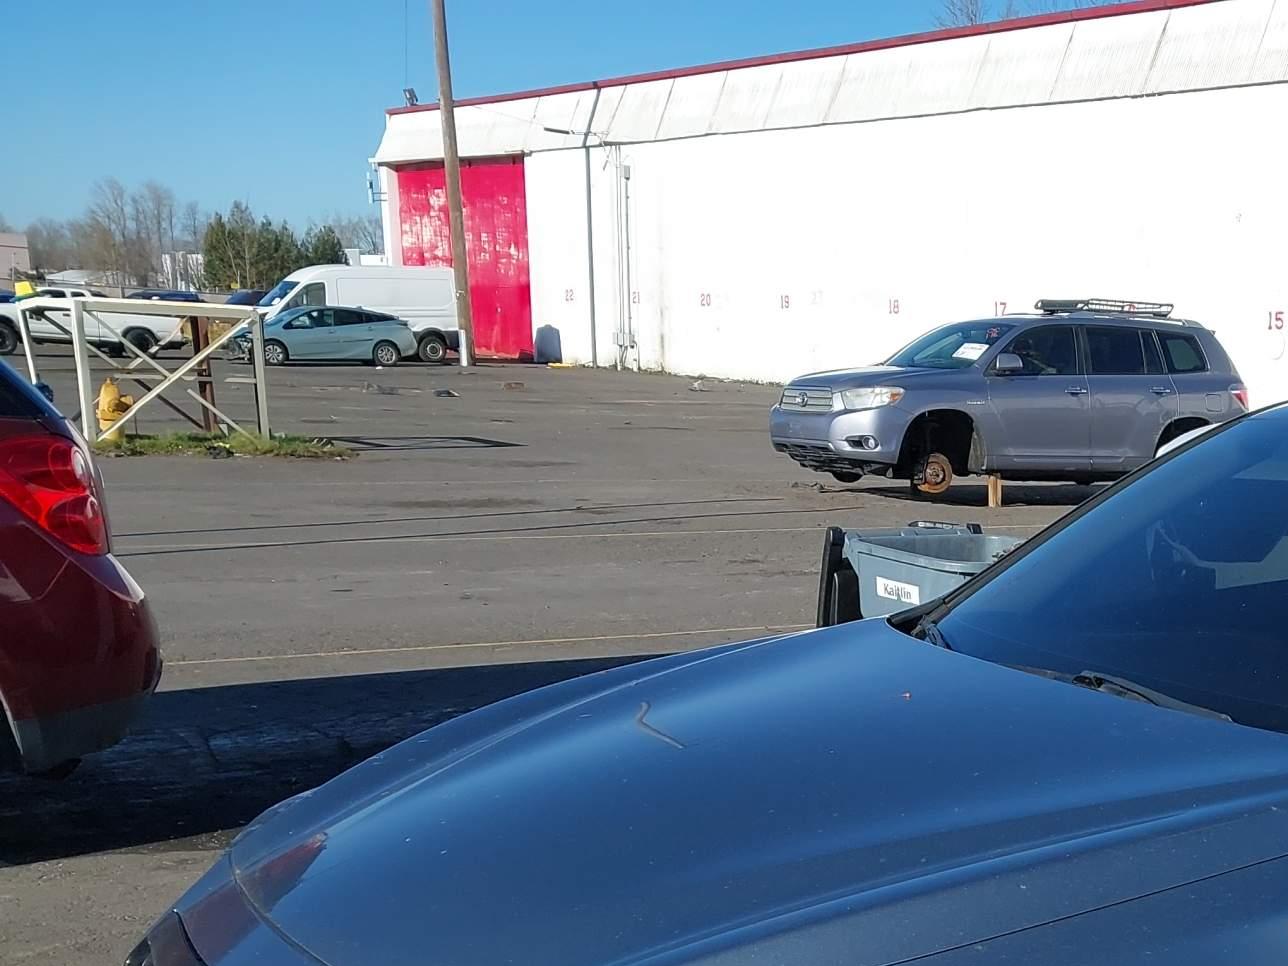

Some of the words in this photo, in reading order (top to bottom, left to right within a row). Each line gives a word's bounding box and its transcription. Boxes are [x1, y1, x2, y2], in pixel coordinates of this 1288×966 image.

[565, 289, 575, 302] 22
[632, 291, 641, 304] 21
[700, 293, 712, 307] 20
[780, 295, 790, 309] 19
[888, 299, 900, 314] 18
[1267, 311, 1285, 331] 15
